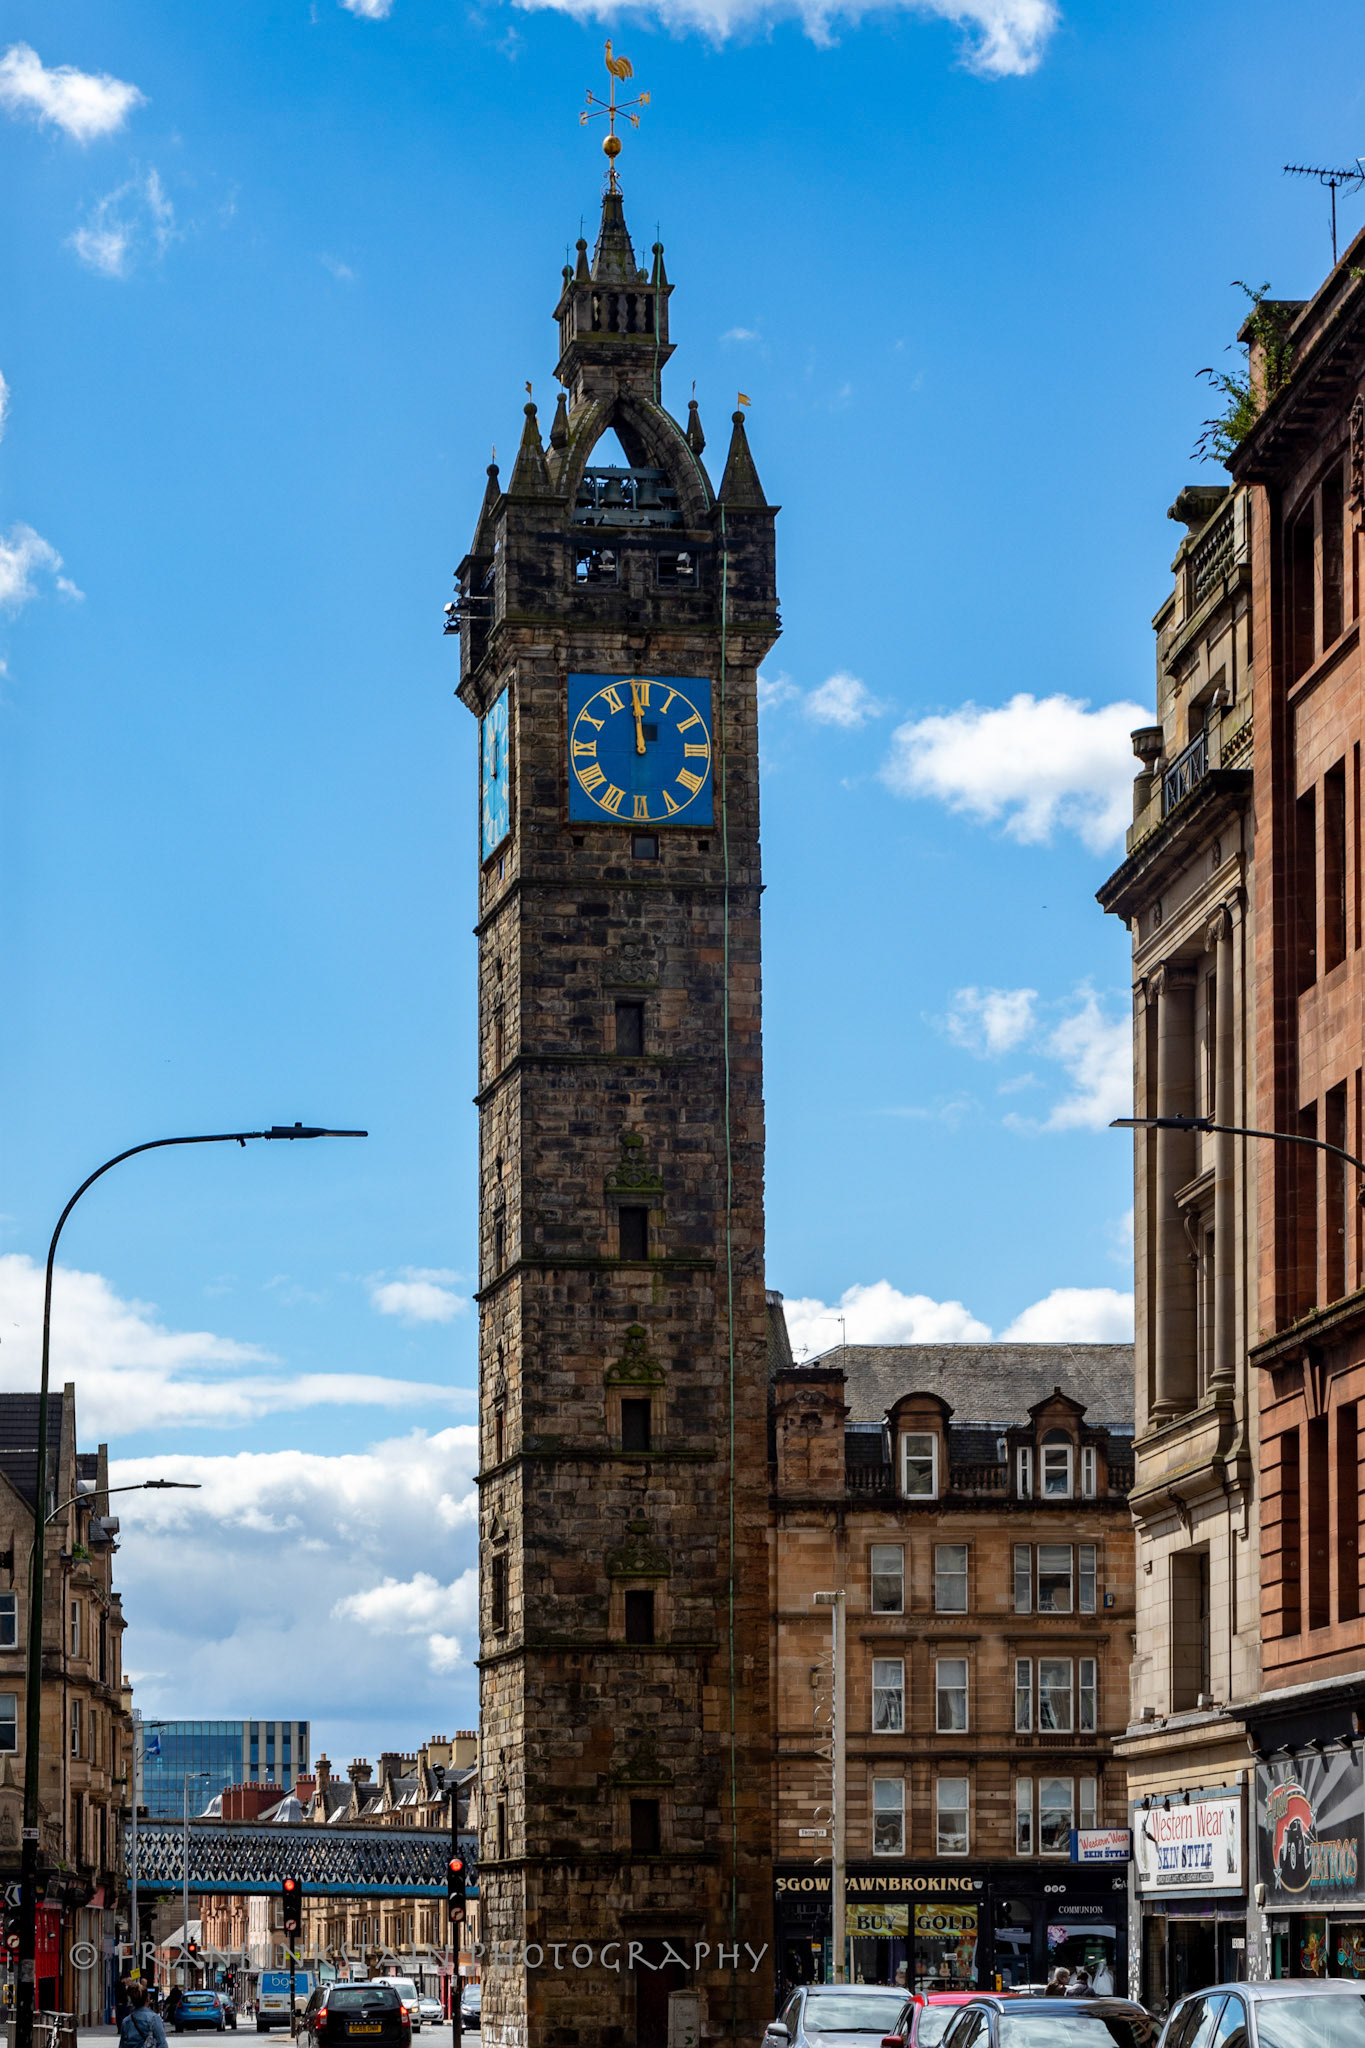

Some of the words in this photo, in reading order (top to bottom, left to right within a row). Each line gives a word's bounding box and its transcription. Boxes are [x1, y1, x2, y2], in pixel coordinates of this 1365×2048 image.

[600, 687, 625, 715] XI
[660, 690, 677, 714] I
[580, 709, 605, 732] X
[676, 713, 700, 734] II
[573, 739, 597, 757] IX
[684, 743, 708, 758] III
[578, 762, 607, 793] VIII
[675, 767, 703, 794] IIII
[599, 783, 626, 813] VII
[632, 795, 650, 819] VI
[662, 790, 680, 813] V
[1152, 1809, 1193, 1842] Western
[1196, 1805, 1224, 1838] Wear
[1079, 1836, 1110, 1850] Western
[1108, 1831, 1129, 1844] Wear
[1084, 1850, 1103, 1858] SKIN
[1105, 1850, 1129, 1858] STYLE
[1158, 1846, 1180, 1870] SKIN
[1181, 1843, 1213, 1869] STYLE
[1309, 1837, 1358, 1886] TATTOOS
[1058, 1905, 1103, 1914] COMMUNION
[857, 1915, 896, 1930] BUY
[917, 1915, 976, 1930] GOLD
